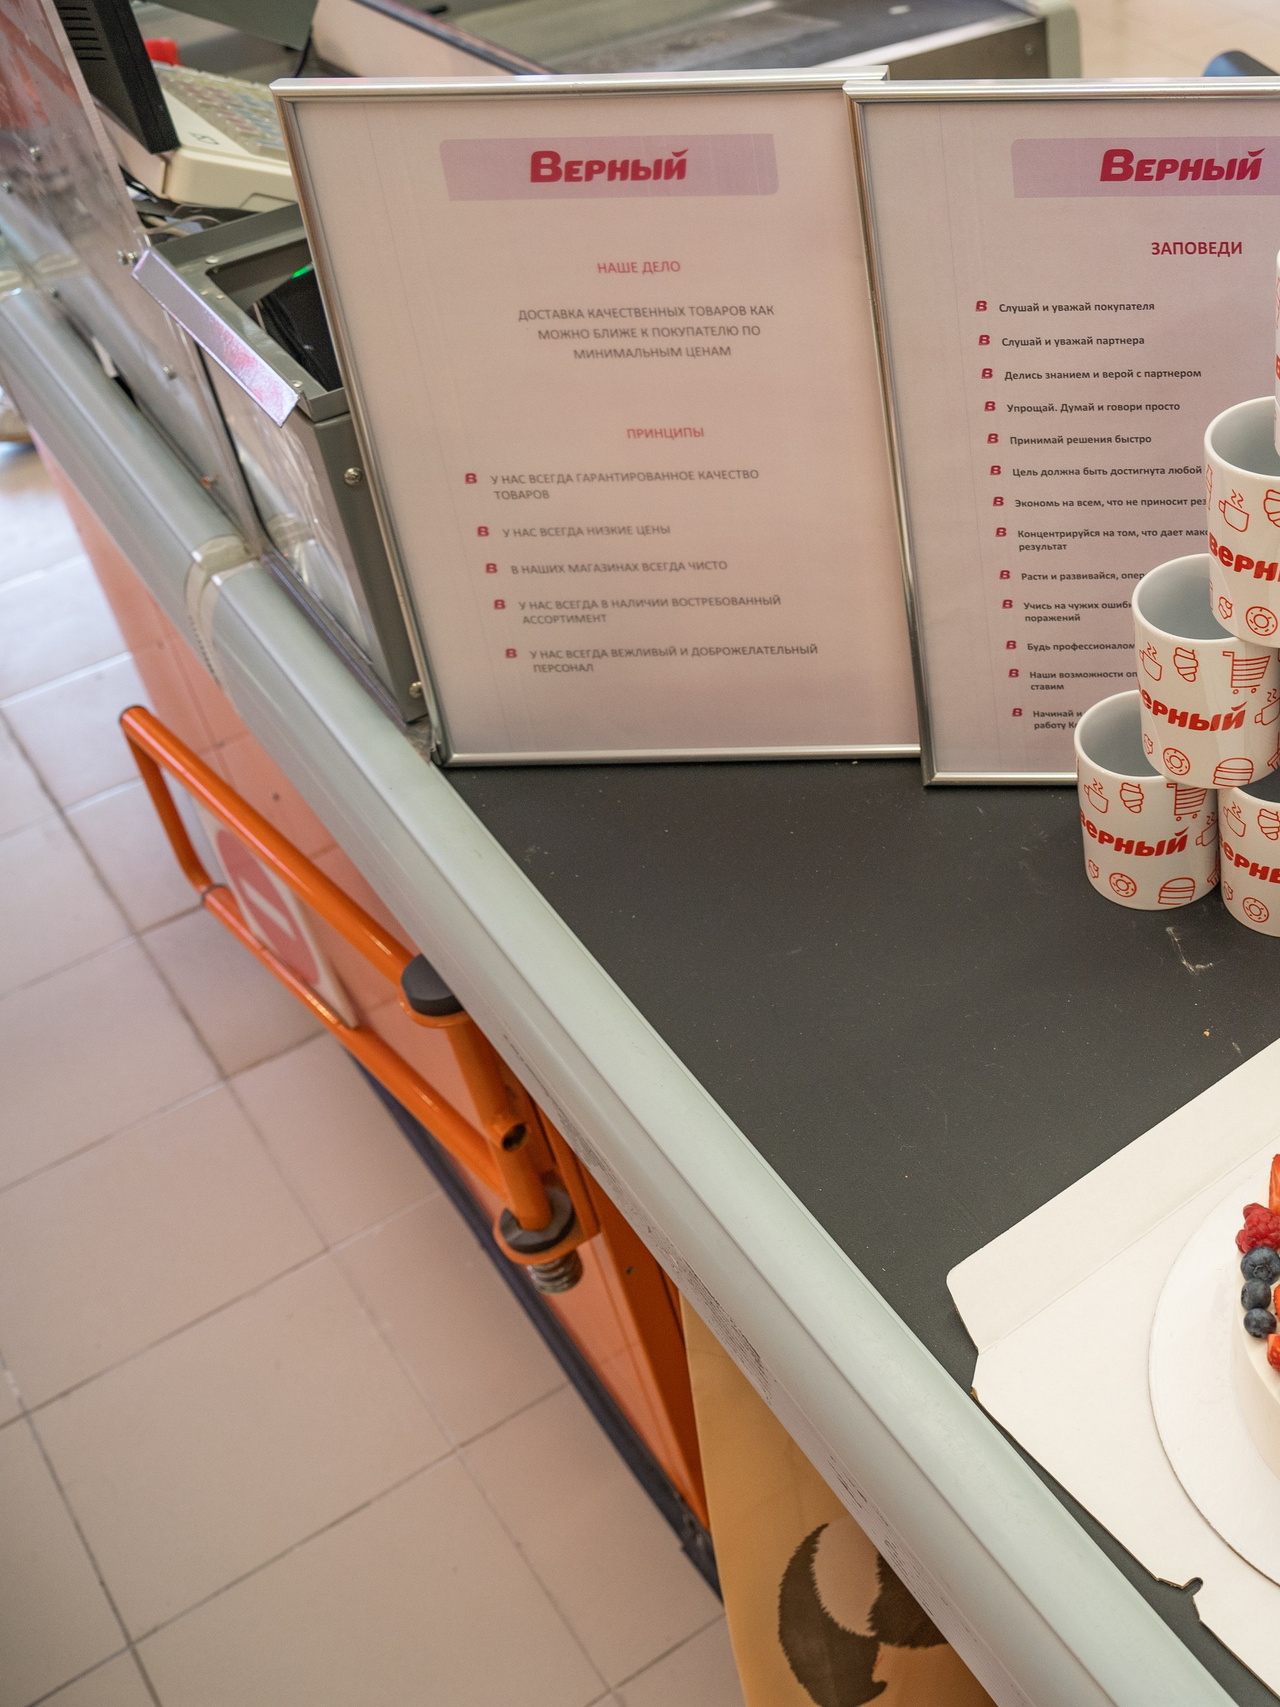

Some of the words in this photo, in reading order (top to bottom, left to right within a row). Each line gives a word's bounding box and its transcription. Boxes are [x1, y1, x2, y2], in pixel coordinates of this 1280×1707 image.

[1151, 241, 1242, 258] ЗАПОВЕДИ
[597, 261, 638, 274] НАШЕ
[642, 260, 681, 275] ДЕЛО
[518, 308, 585, 322] ДОСТАВКА
[587, 306, 686, 319] КАЧЕСТВЕННЫХ
[688, 305, 747, 316] ТОВАРОВ
[749, 305, 774, 316] КАК
[998, 302, 1040, 314] Слушай
[1051, 302, 1091, 313] уважай
[1094, 303, 1155, 313] покупателя
[537, 328, 590, 340] МОЖНО
[593, 327, 638, 339] БЛИЖЕ
[640, 328, 649, 337] К
[651, 325, 739, 337] ПОКУПАТЕЛЮ
[742, 325, 761, 336] ПО
[1001, 336, 1042, 348] Слушай
[1053, 336, 1093, 347] уважай
[1096, 337, 1145, 347] партнера
[573, 347, 682, 359] МИНИМАЛЬНЫМ
[685, 346, 731, 358] ЦЕНАМ
[1004, 371, 1043, 381] Делись
[1102, 369, 1134, 380] верой
[1144, 370, 1202, 380] партнером
[1006, 403, 1058, 414] Упрощай.
[1060, 402, 1095, 413] Думай
[1106, 404, 1143, 412] говори
[1145, 403, 1180, 412] просто
[626, 427, 704, 440] ПРИНЦИПЫ
[1010, 435, 1064, 446] Принимай
[1066, 436, 1112, 445] решения
[1114, 434, 1152, 445] быстро
[489, 475, 498, 485] У
[501, 474, 526, 484] НАС
[528, 473, 574, 485] ВСЕГДА
[576, 470, 695, 482] ГАРАНТИРОВАННОЕ
[697, 469, 759, 480] КАЧЕСТВО
[1012, 468, 1038, 478] Цель
[1040, 469, 1080, 477] должна
[1082, 466, 1108, 475] быть
[1109, 468, 1166, 476] достигнута
[1167, 465, 1202, 474] любой
[493, 489, 550, 500] ТОВАРОВ
[1014, 499, 1060, 507] Экономь
[1140, 499, 1187, 507] приносит
[502, 528, 510, 538] У
[512, 527, 537, 537] НАС
[539, 526, 585, 538] ВСЕГДА
[586, 525, 633, 536] НИЗКИЕ
[636, 525, 671, 536] ЦЕНЫ
[1017, 528, 1100, 539] Концентрируйся
[1116, 530, 1139, 538] том,
[1160, 529, 1183, 538] дает
[1018, 544, 1067, 552] результат
[510, 565, 519, 575] В
[521, 564, 565, 574] НАШИХ
[567, 563, 639, 573] МАГАЗИНАХ
[641, 562, 686, 572] ВСЕГДА
[688, 560, 728, 570] ЧИСТО
[1021, 572, 1048, 580] Расти
[1059, 571, 1119, 582] развивайся,
[518, 601, 526, 610] У
[528, 600, 553, 610] НАС
[554, 599, 599, 610] ВСЕГДА
[600, 599, 609, 609] В
[611, 598, 669, 608] НАЛИЧИИ
[671, 594, 781, 607] ВОСТРЕБОВАННЫЙ
[1023, 602, 1052, 610] Учись
[1068, 603, 1099, 611] чужих
[522, 613, 607, 625] АССОРТИМЕНТ
[1024, 613, 1081, 623] поражений
[529, 651, 537, 659] У
[539, 650, 563, 659] НАС
[565, 649, 609, 660] ВСЕГДА
[610, 645, 677, 658] ВЕЖЛИВЫЙ
[679, 647, 688, 656] И
[691, 643, 818, 657] ДОБРОЖЕЛАТЕЛЬНЫЙ
[1027, 643, 1051, 652] Будь
[533, 663, 594, 673] ПЕРСОНАЛ
[1029, 671, 1057, 679] Наши
[1058, 671, 1124, 679] возможности
[1032, 709, 1074, 718] Начинай
[1034, 721, 1066, 730] работу
